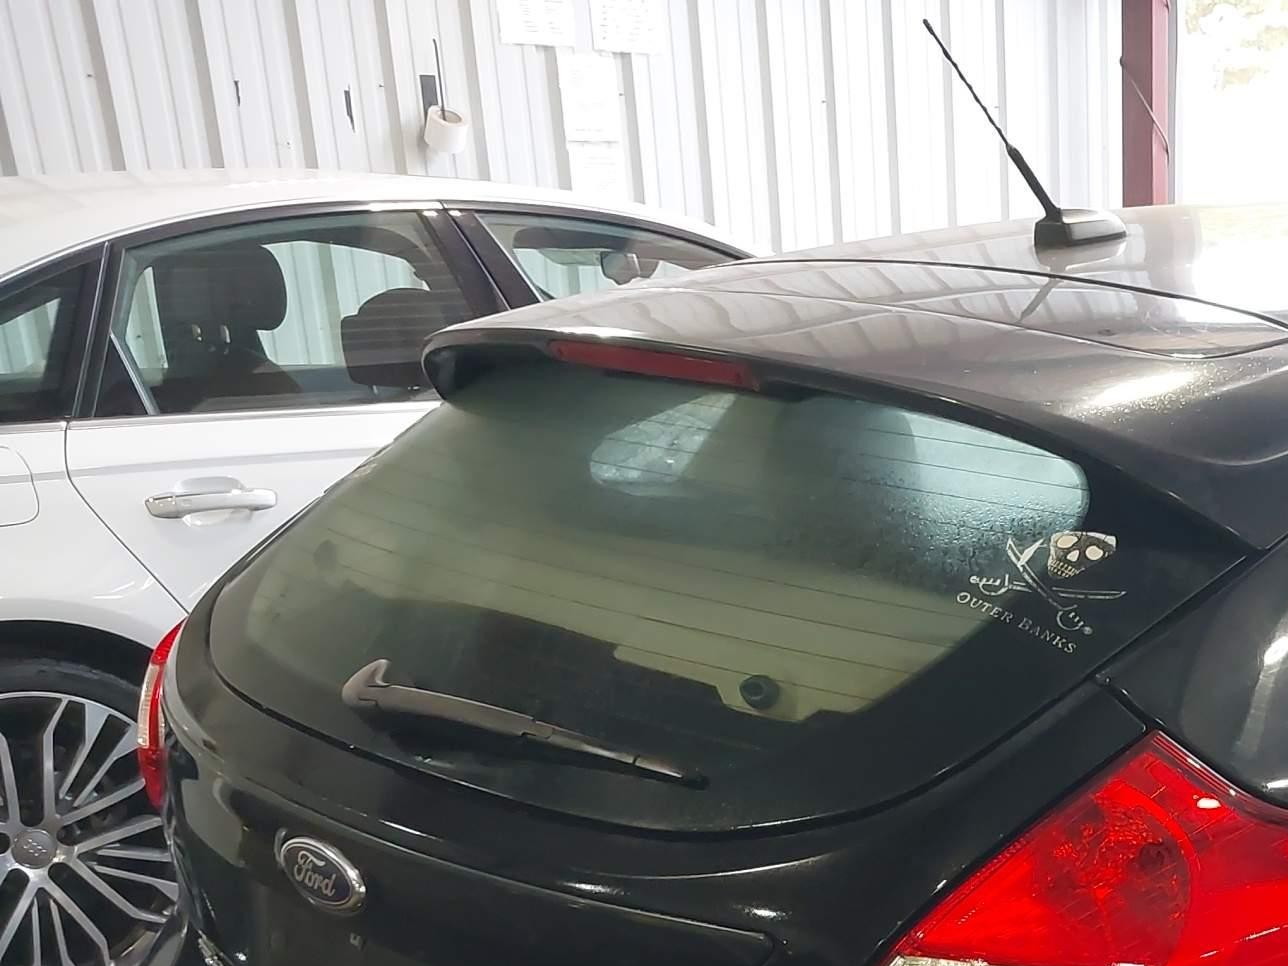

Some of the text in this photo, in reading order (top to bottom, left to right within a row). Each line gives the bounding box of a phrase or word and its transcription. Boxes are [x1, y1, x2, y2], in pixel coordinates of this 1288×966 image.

[956, 592, 1077, 654] OUTER BANKS
[294, 850, 336, 897] Ford
